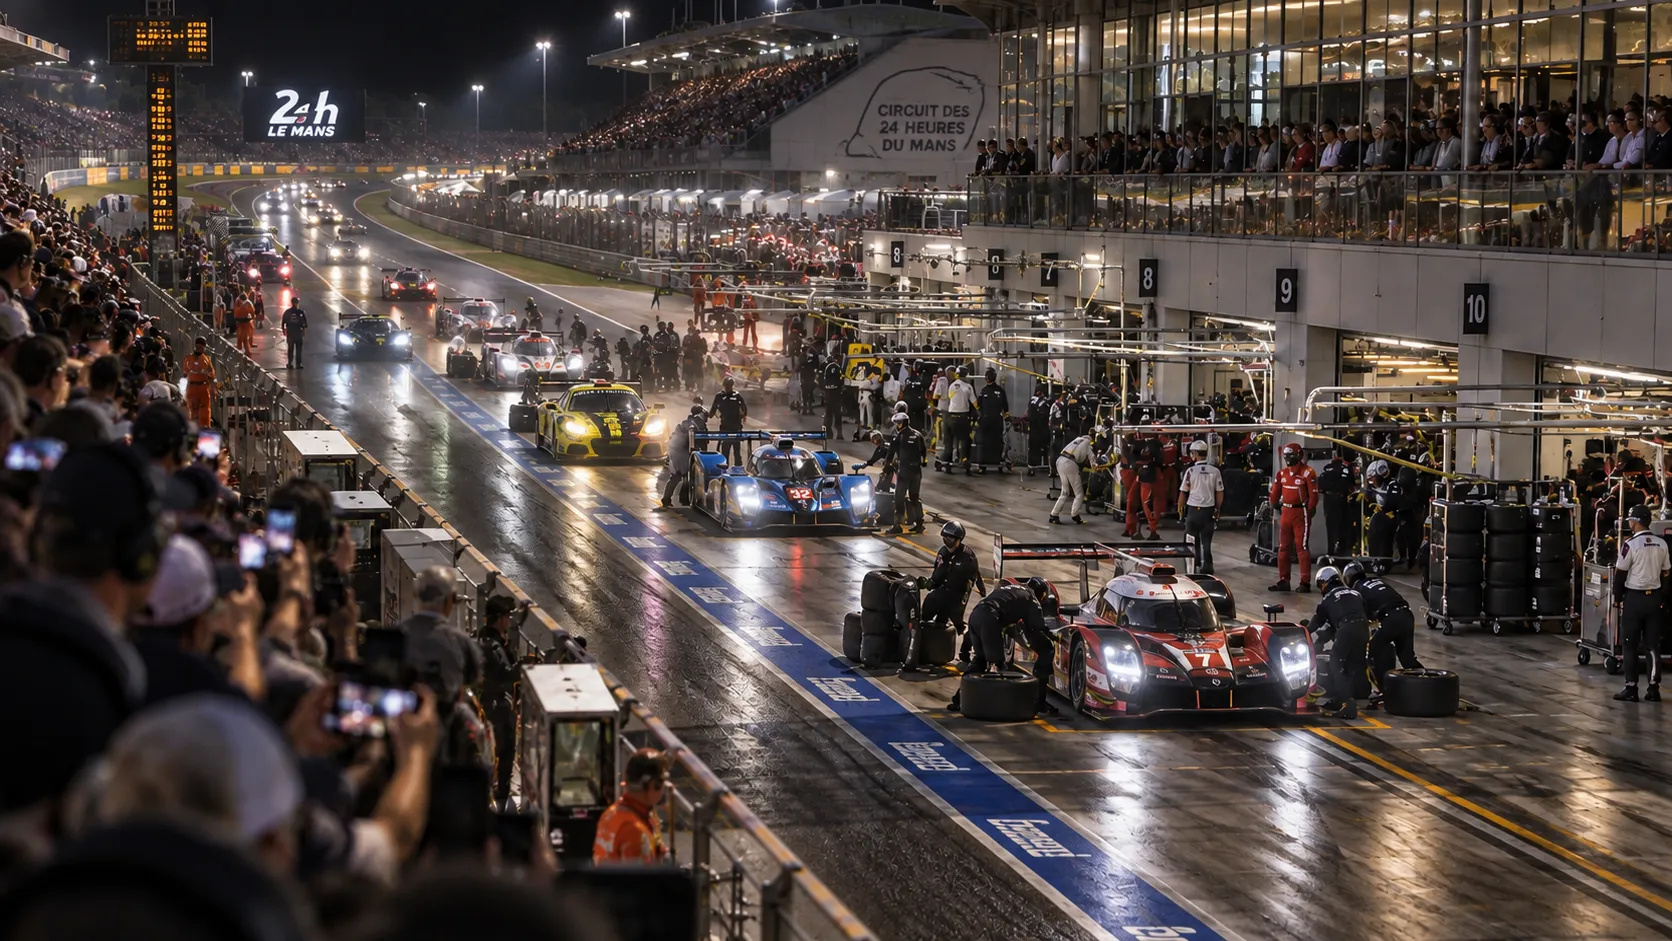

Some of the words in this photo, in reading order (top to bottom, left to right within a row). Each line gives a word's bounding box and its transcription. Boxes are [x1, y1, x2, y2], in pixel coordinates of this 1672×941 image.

[878, 104, 939, 117] CIRCUIT
[943, 105, 970, 118] DES
[267, 126, 288, 137] LE
[290, 126, 335, 137] MANS
[879, 121, 899, 134] 24
[905, 122, 965, 134] HEURES
[882, 139, 904, 151] DU
[910, 139, 956, 151] MANS
[893, 247, 900, 263] 8
[1142, 267, 1153, 290] 8
[1281, 278, 1292, 304] 9
[1467, 294, 1485, 324] 10
[1195, 653, 1211, 667] 7
